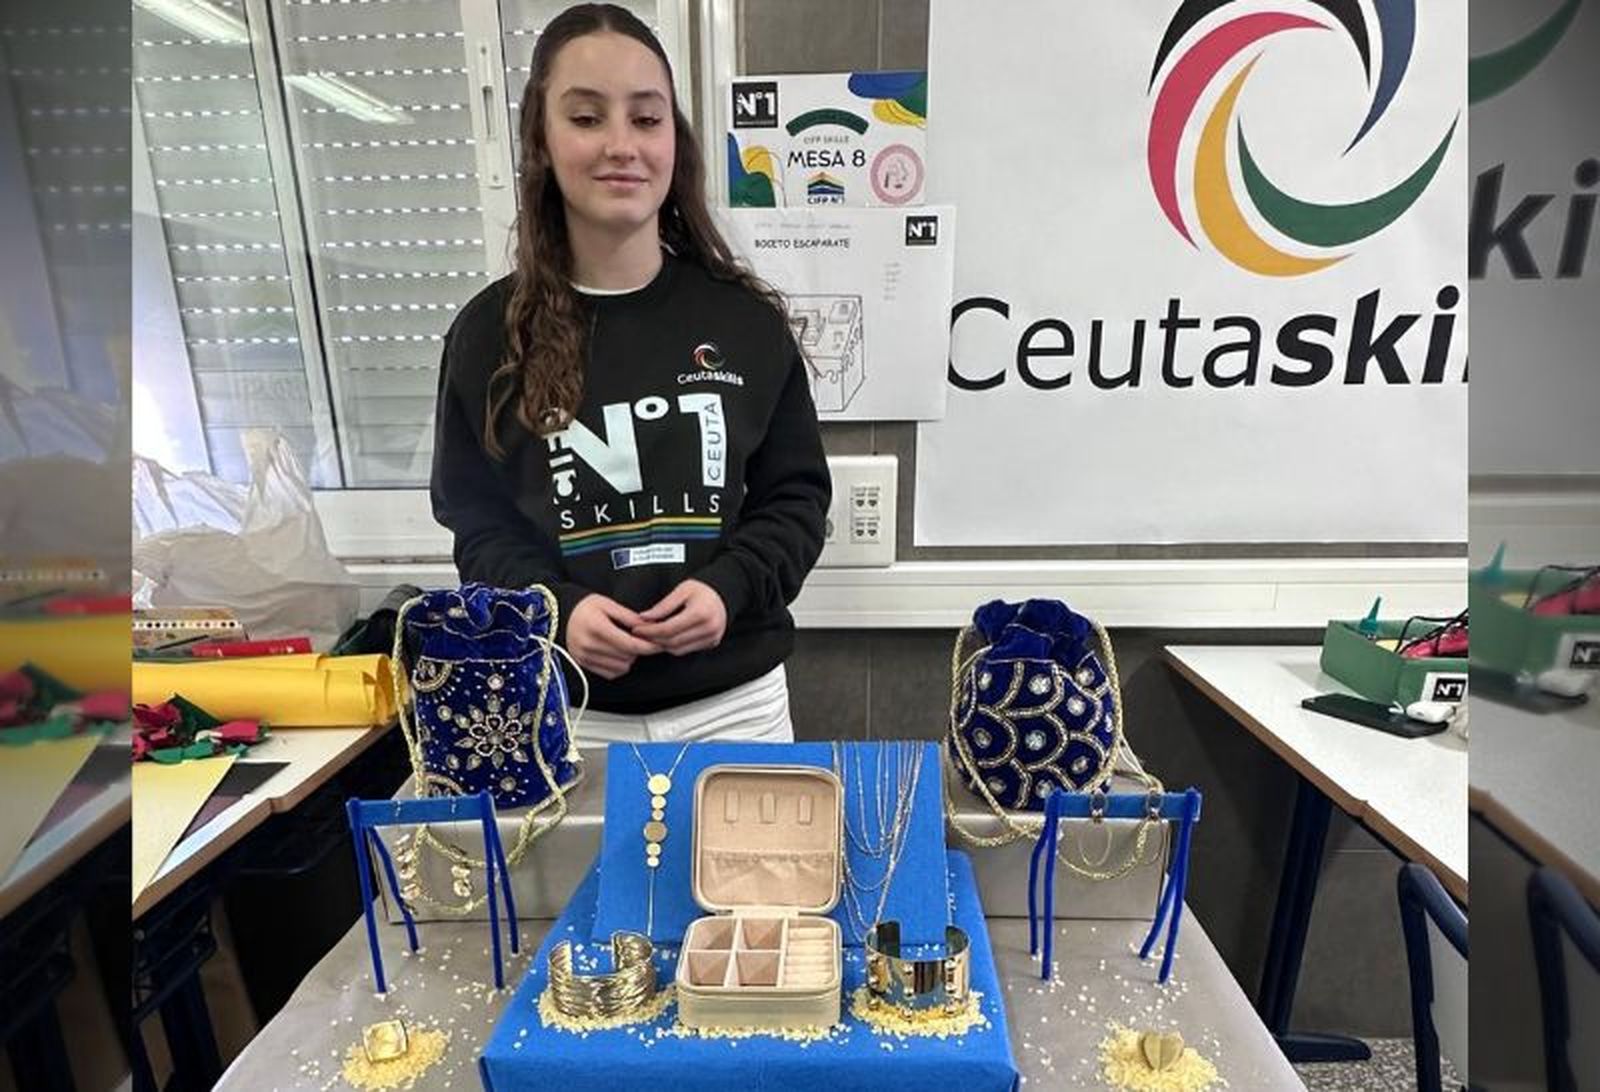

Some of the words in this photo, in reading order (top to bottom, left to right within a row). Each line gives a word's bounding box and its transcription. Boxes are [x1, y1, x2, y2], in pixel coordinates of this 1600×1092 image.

[787, 149, 845, 168] MESA
[852, 149, 866, 167] 8
[755, 239, 790, 248] BOCETO
[947, 285, 1468, 391] Ceutaski
[677, 371, 743, 385] Ceutaskills
[704, 402, 721, 481] CEUTA
[560, 492, 721, 530] SKILLS
